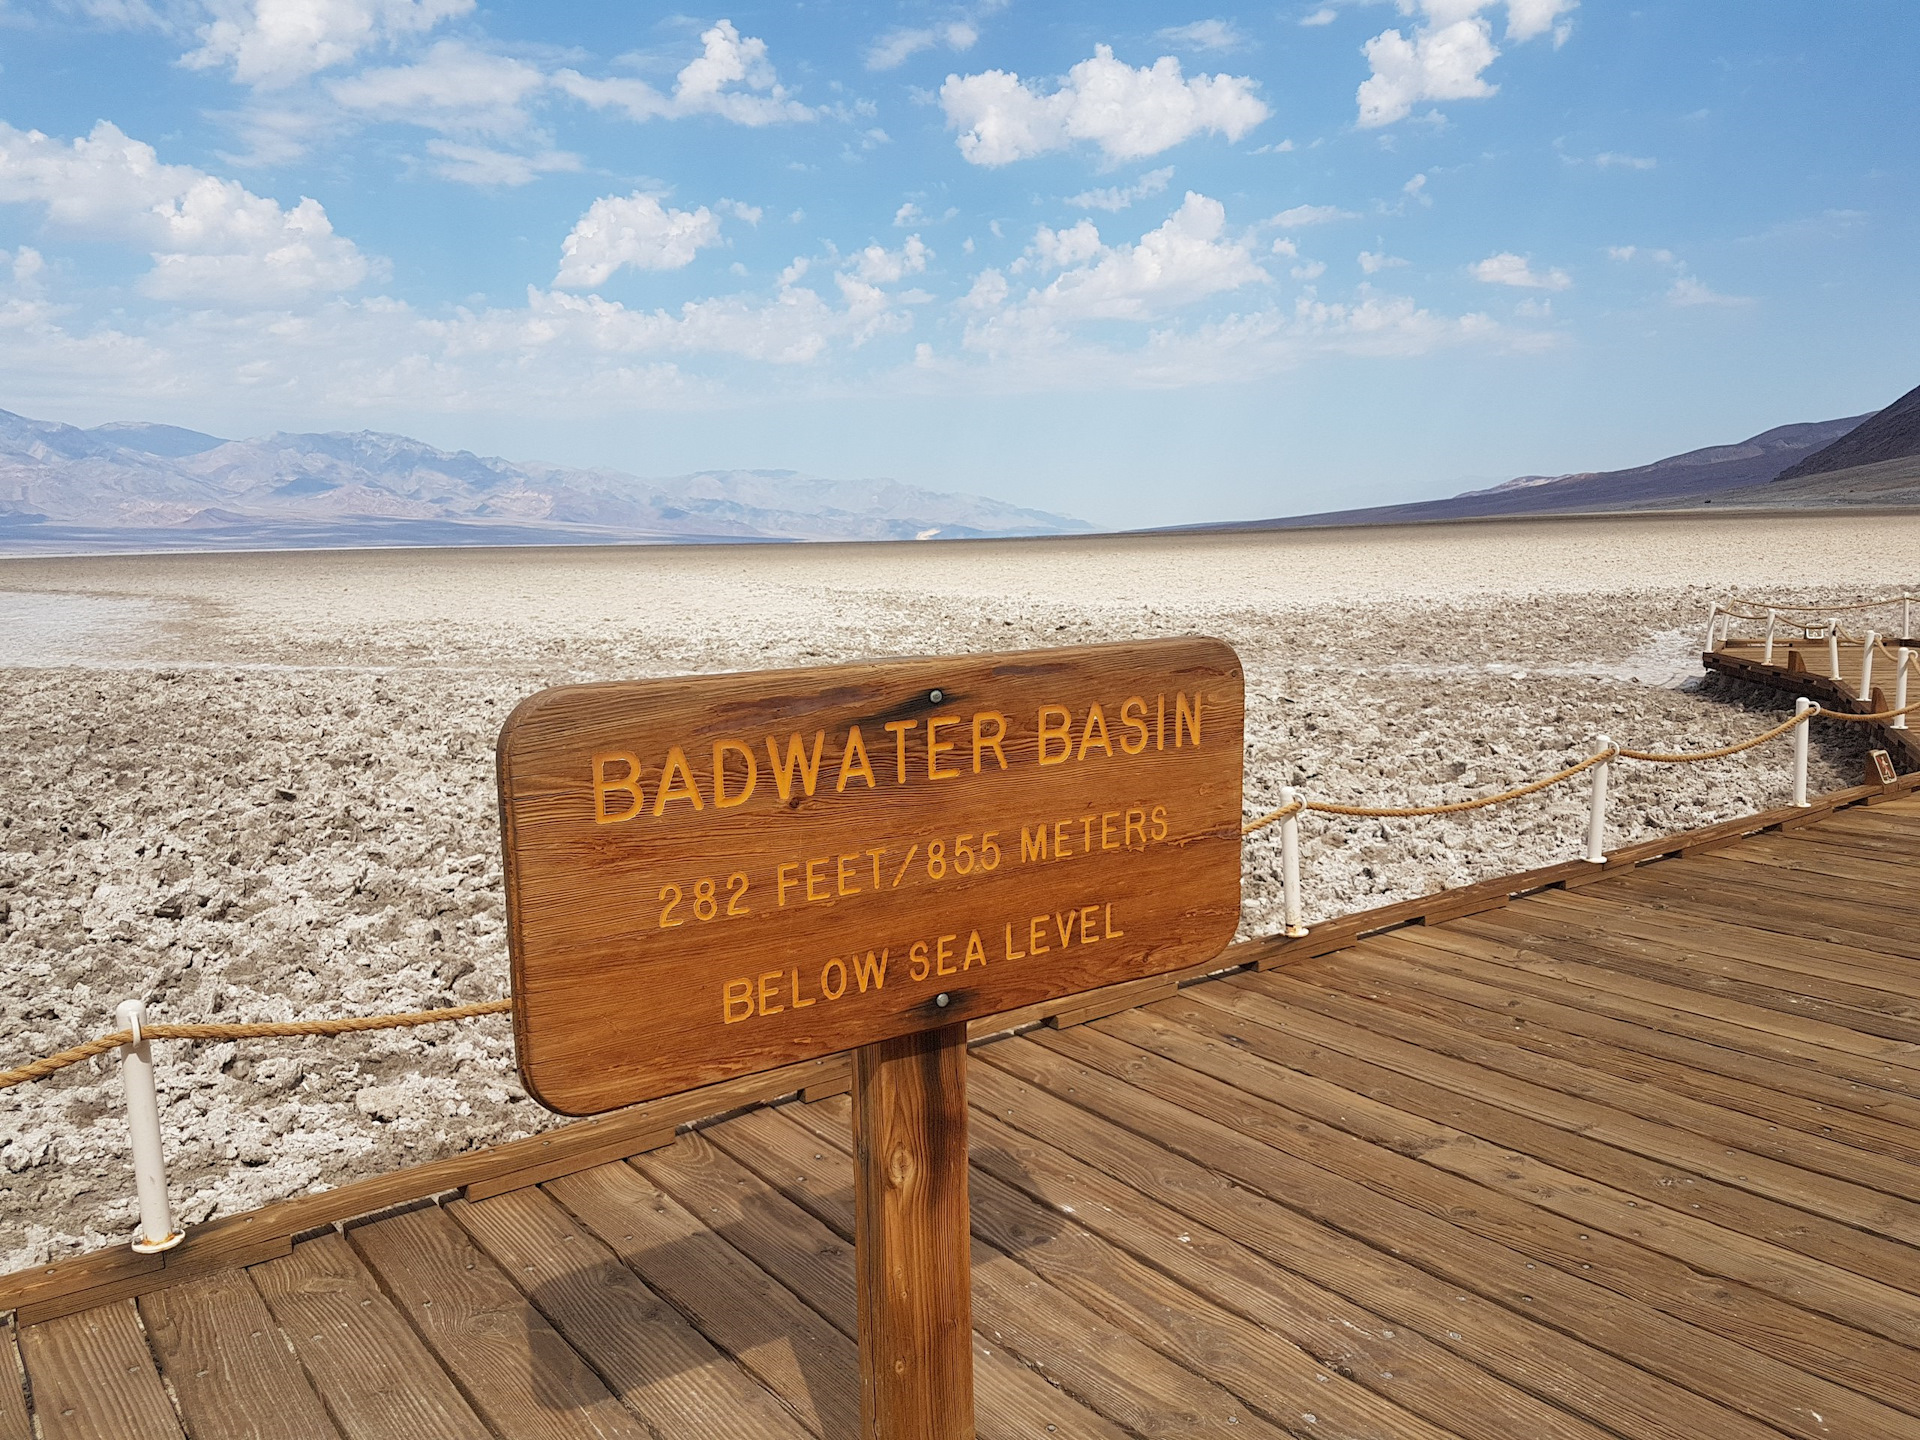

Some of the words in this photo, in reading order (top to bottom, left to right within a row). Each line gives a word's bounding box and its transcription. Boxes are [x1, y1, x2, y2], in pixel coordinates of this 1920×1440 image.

[592, 711, 1008, 824] BADWATER
[1038, 693, 1201, 766] BASIN
[659, 872, 750, 928] 282
[1020, 806, 1169, 863] METERS
[723, 948, 890, 1024] BELOW
[909, 929, 987, 982] SEA
[1005, 902, 1124, 961] LEVEL
